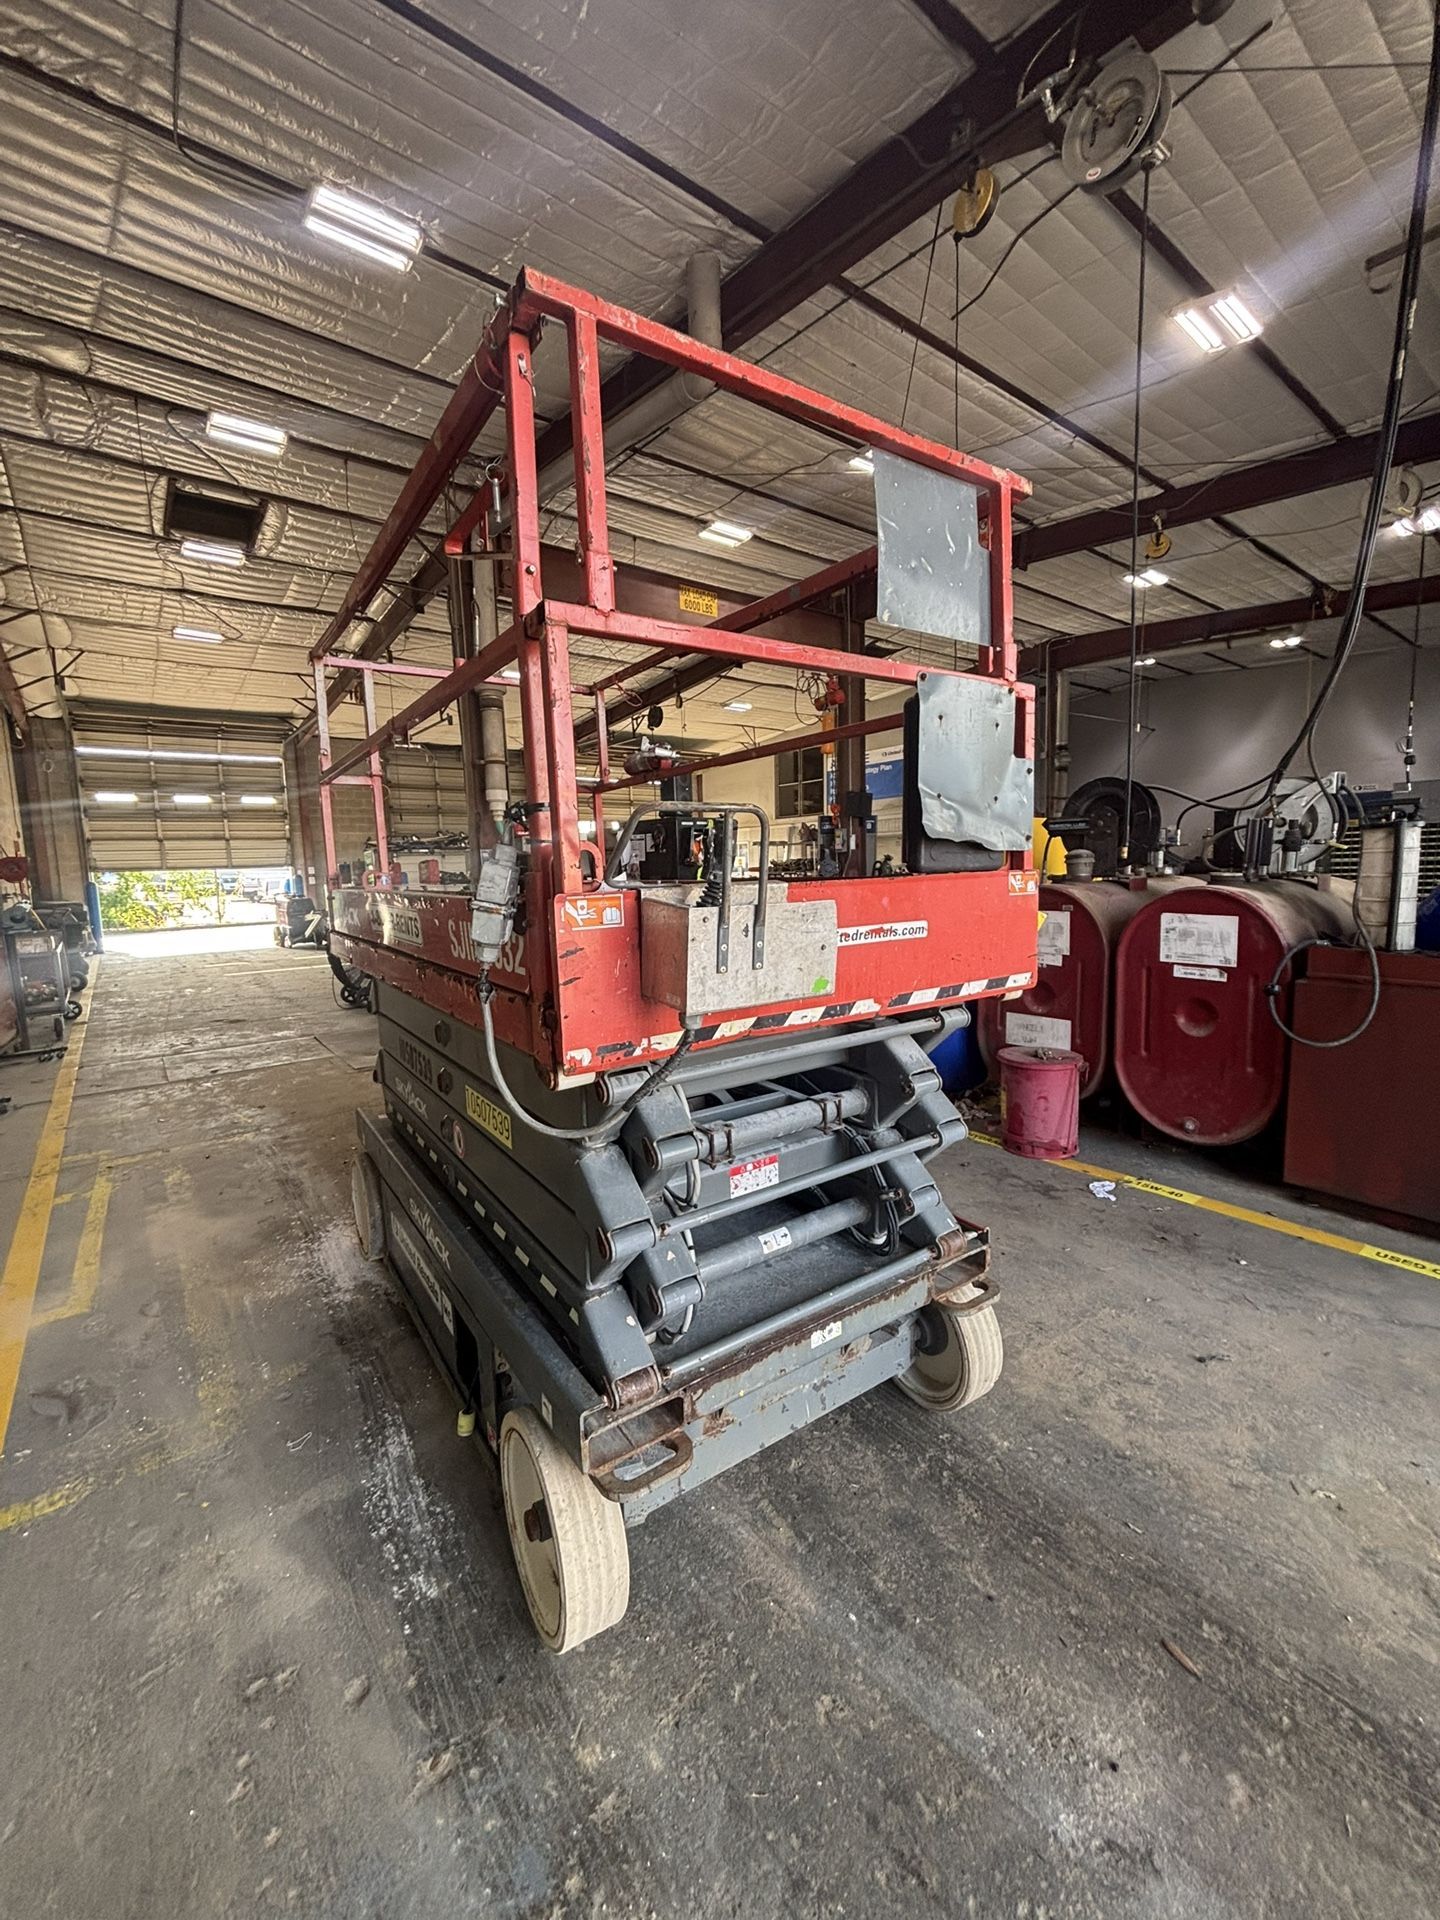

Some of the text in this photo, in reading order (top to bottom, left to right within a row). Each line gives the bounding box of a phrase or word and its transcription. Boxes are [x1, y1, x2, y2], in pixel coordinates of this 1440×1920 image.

[684, 598, 714, 614] 6000 LBS
[836, 925, 926, 943] tedrentals.com
[466, 1088, 510, 1140] 10507539
[1136, 1181, 1184, 1198] 15W-40
[1375, 1251, 1427, 1270] USED
